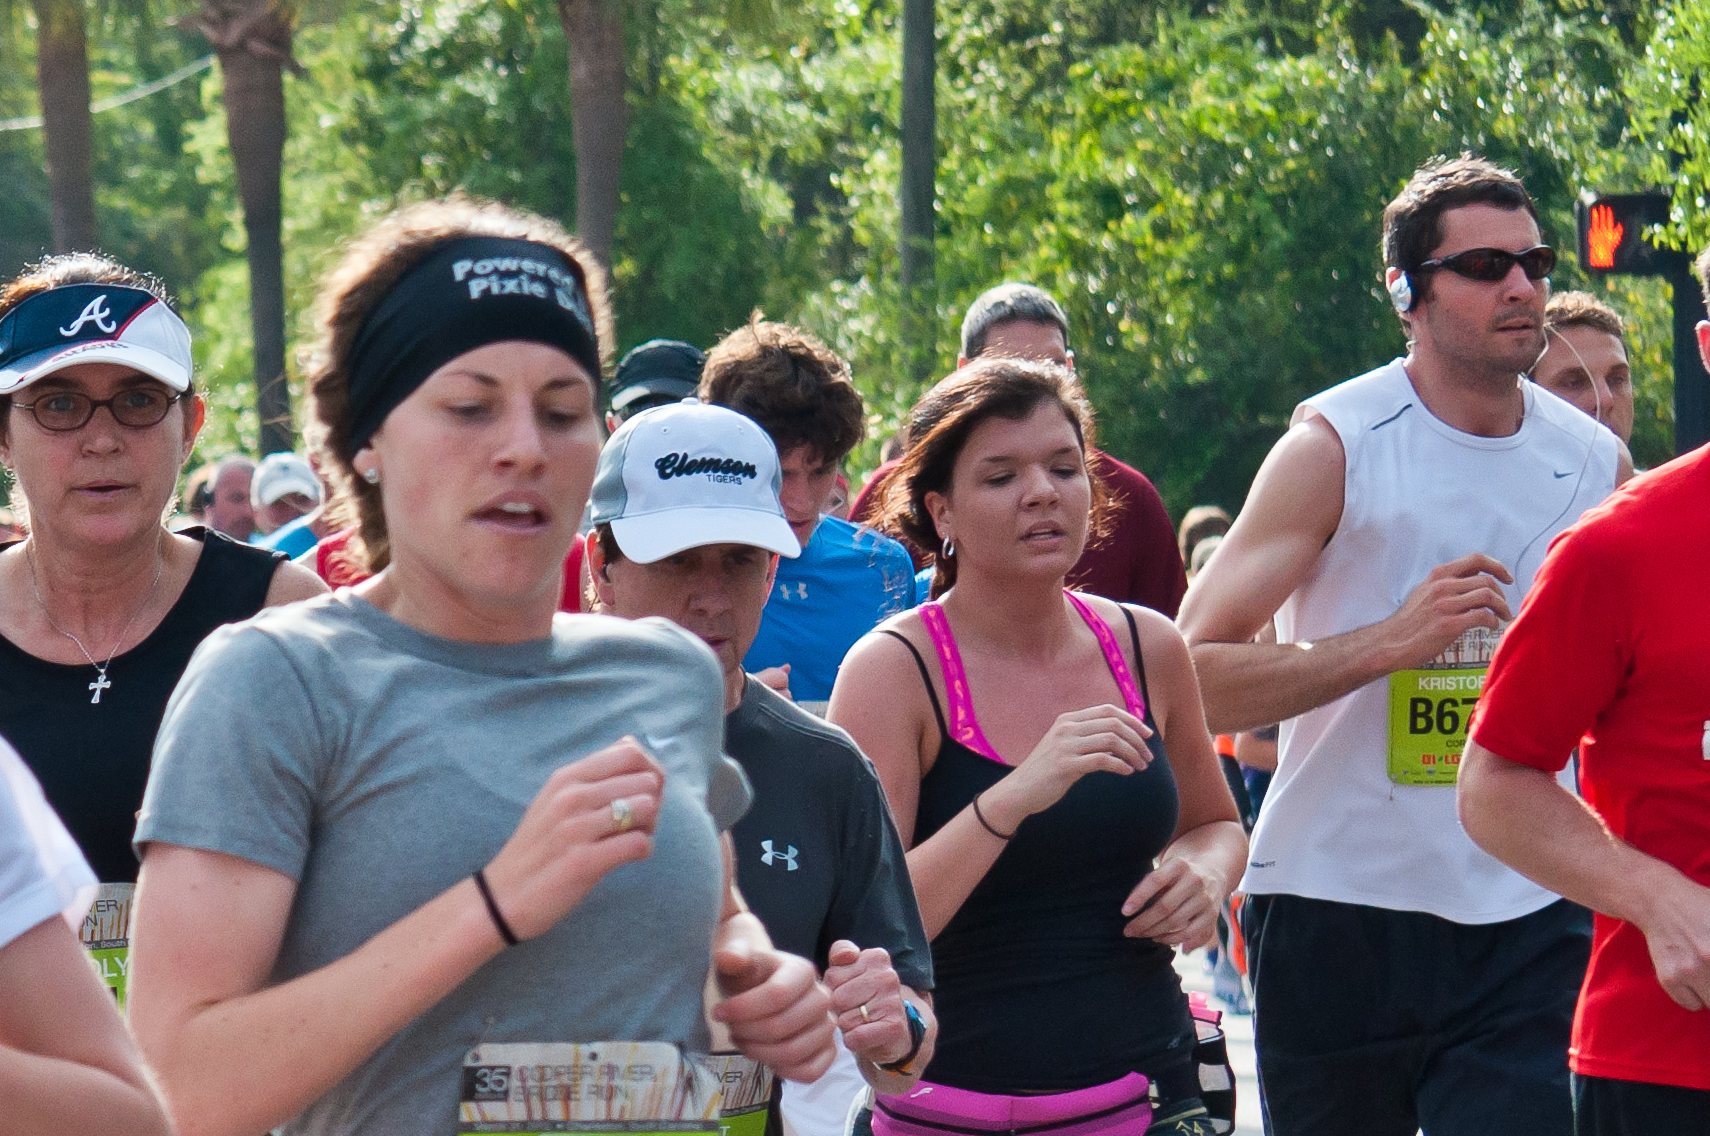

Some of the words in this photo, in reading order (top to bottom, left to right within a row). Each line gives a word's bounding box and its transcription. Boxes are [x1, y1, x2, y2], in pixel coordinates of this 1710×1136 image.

[59, 294, 117, 337] A
[654, 452, 757, 480] Clemson
[706, 474, 743, 485] TIGERS
[1409, 697, 1480, 735] B67
[475, 1068, 508, 1092] 35
